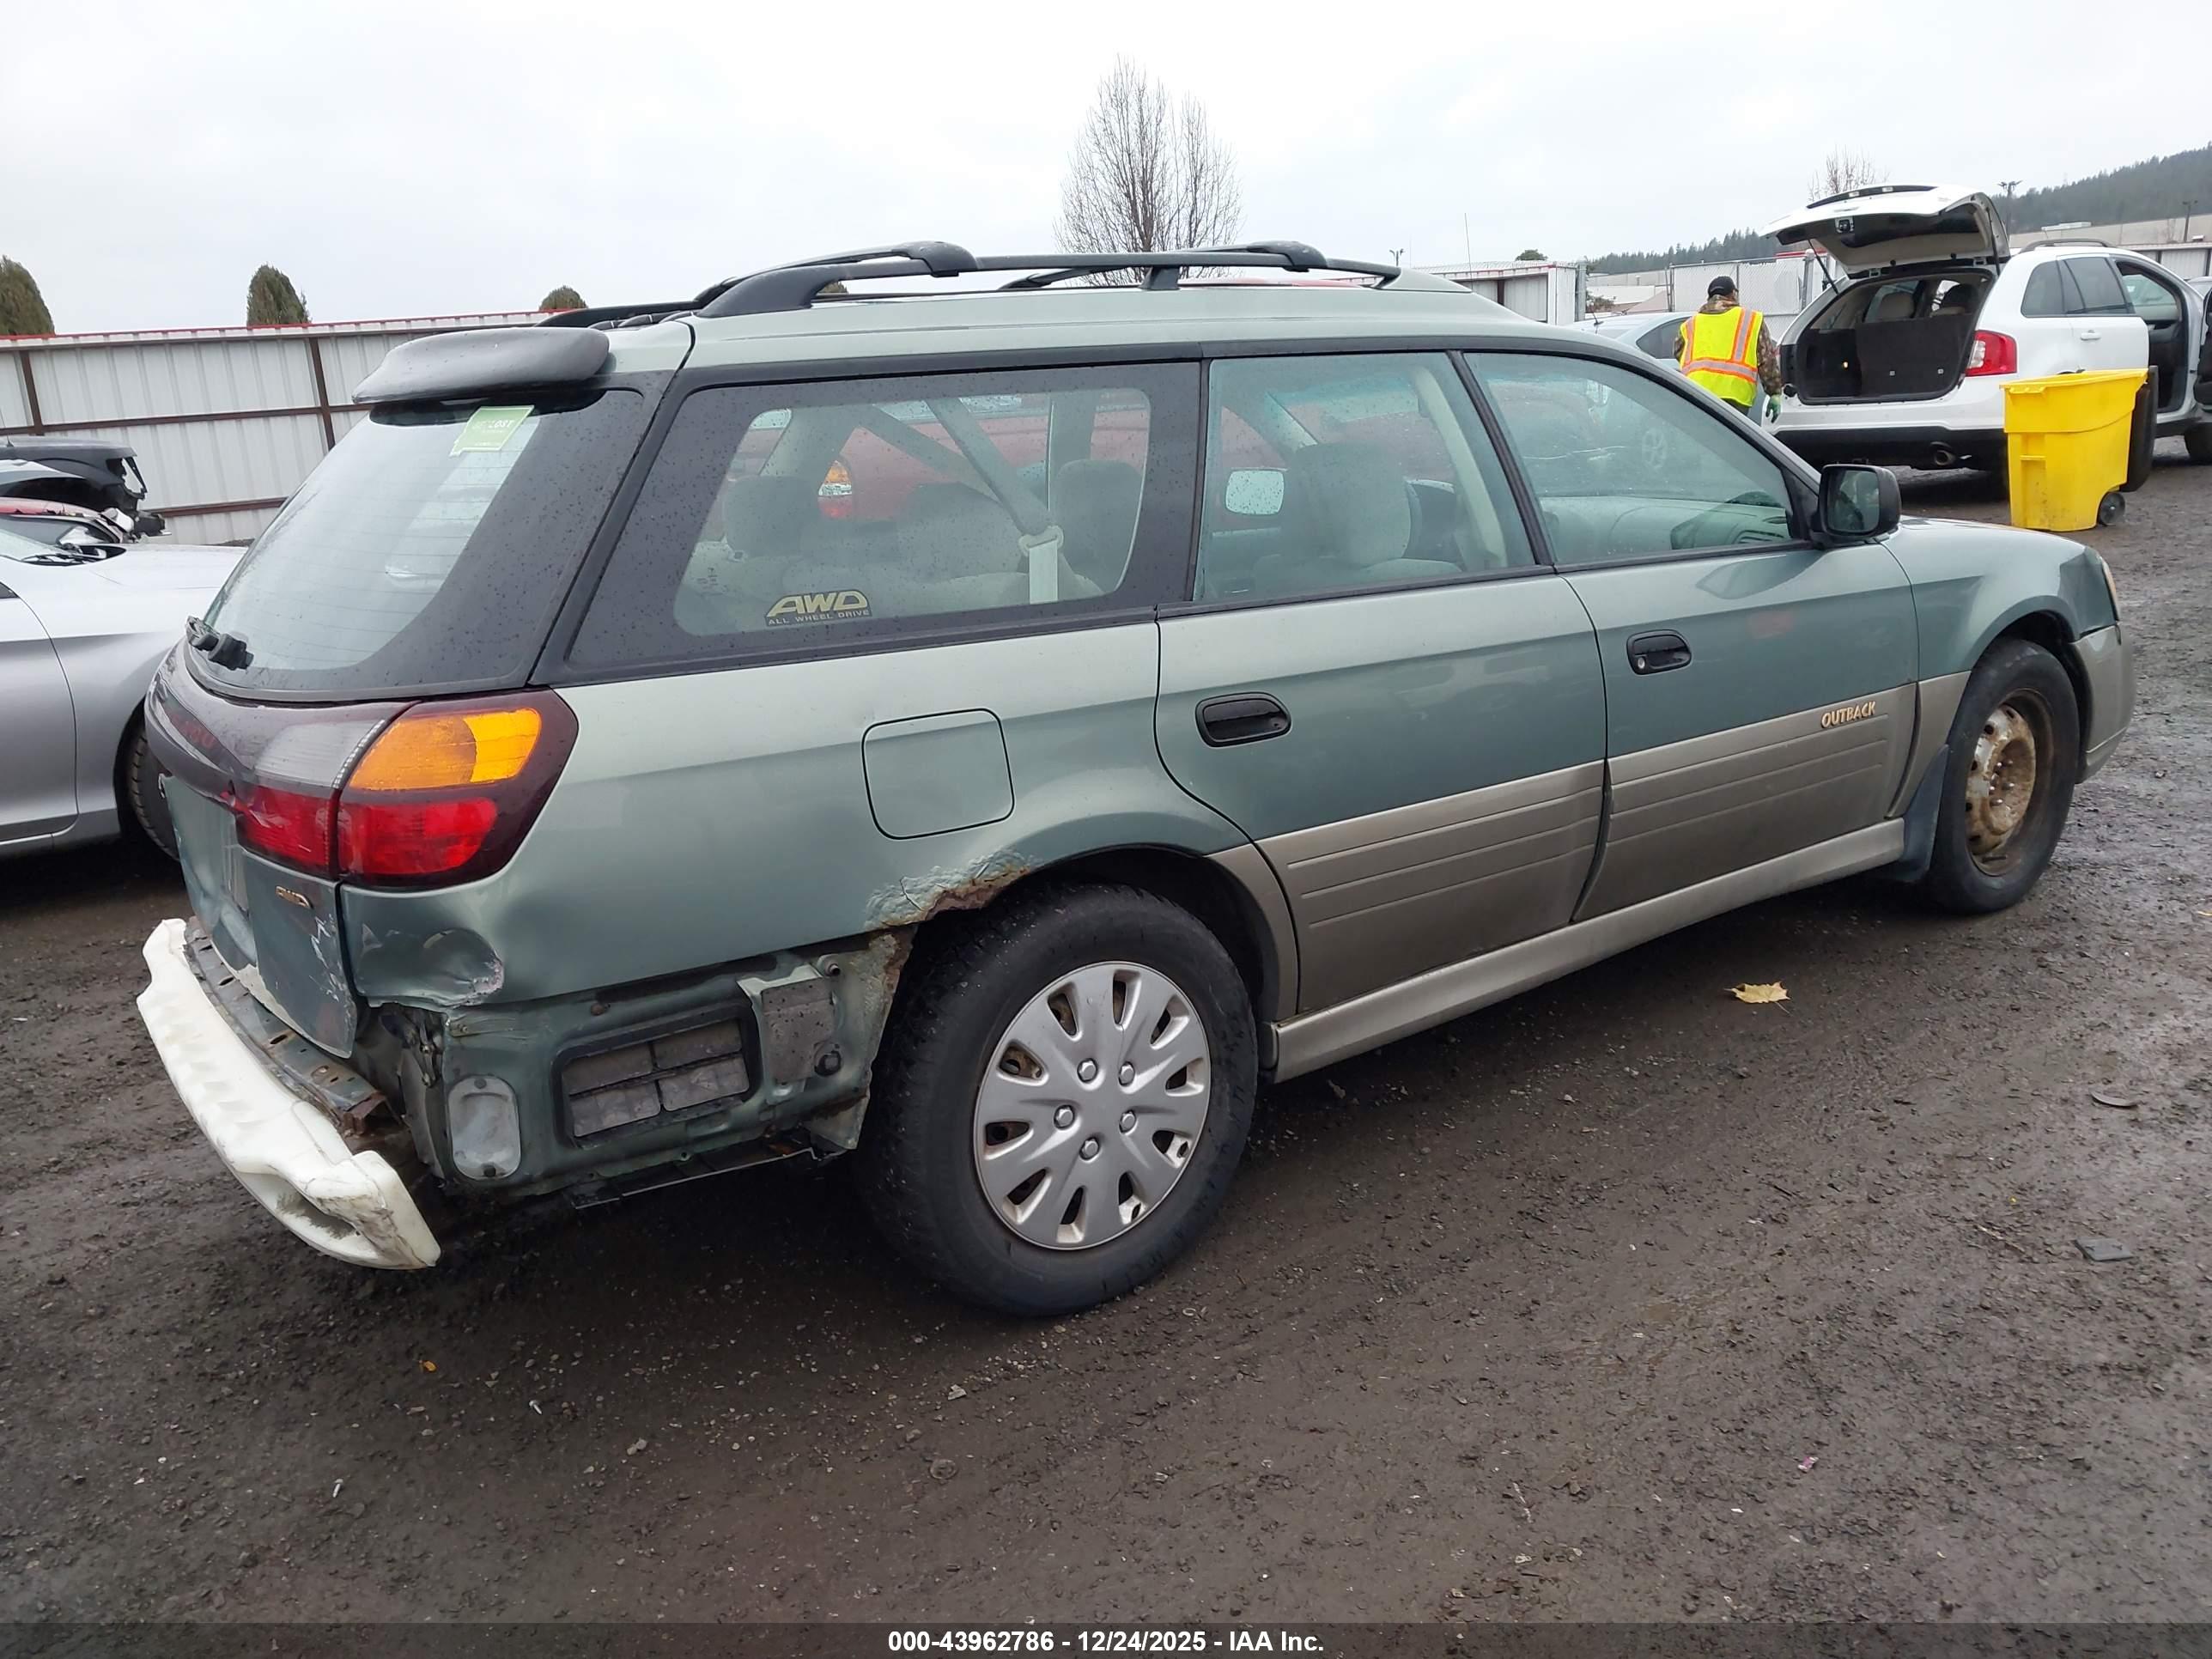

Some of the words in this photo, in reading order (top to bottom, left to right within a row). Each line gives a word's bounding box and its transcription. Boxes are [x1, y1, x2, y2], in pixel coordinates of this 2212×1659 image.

[767, 590, 868, 617] AWD
[769, 617, 789, 626] ALL
[795, 613, 833, 623] WHEEL
[837, 610, 870, 618] DRIVE
[1820, 701, 1876, 728] OUTBACK
